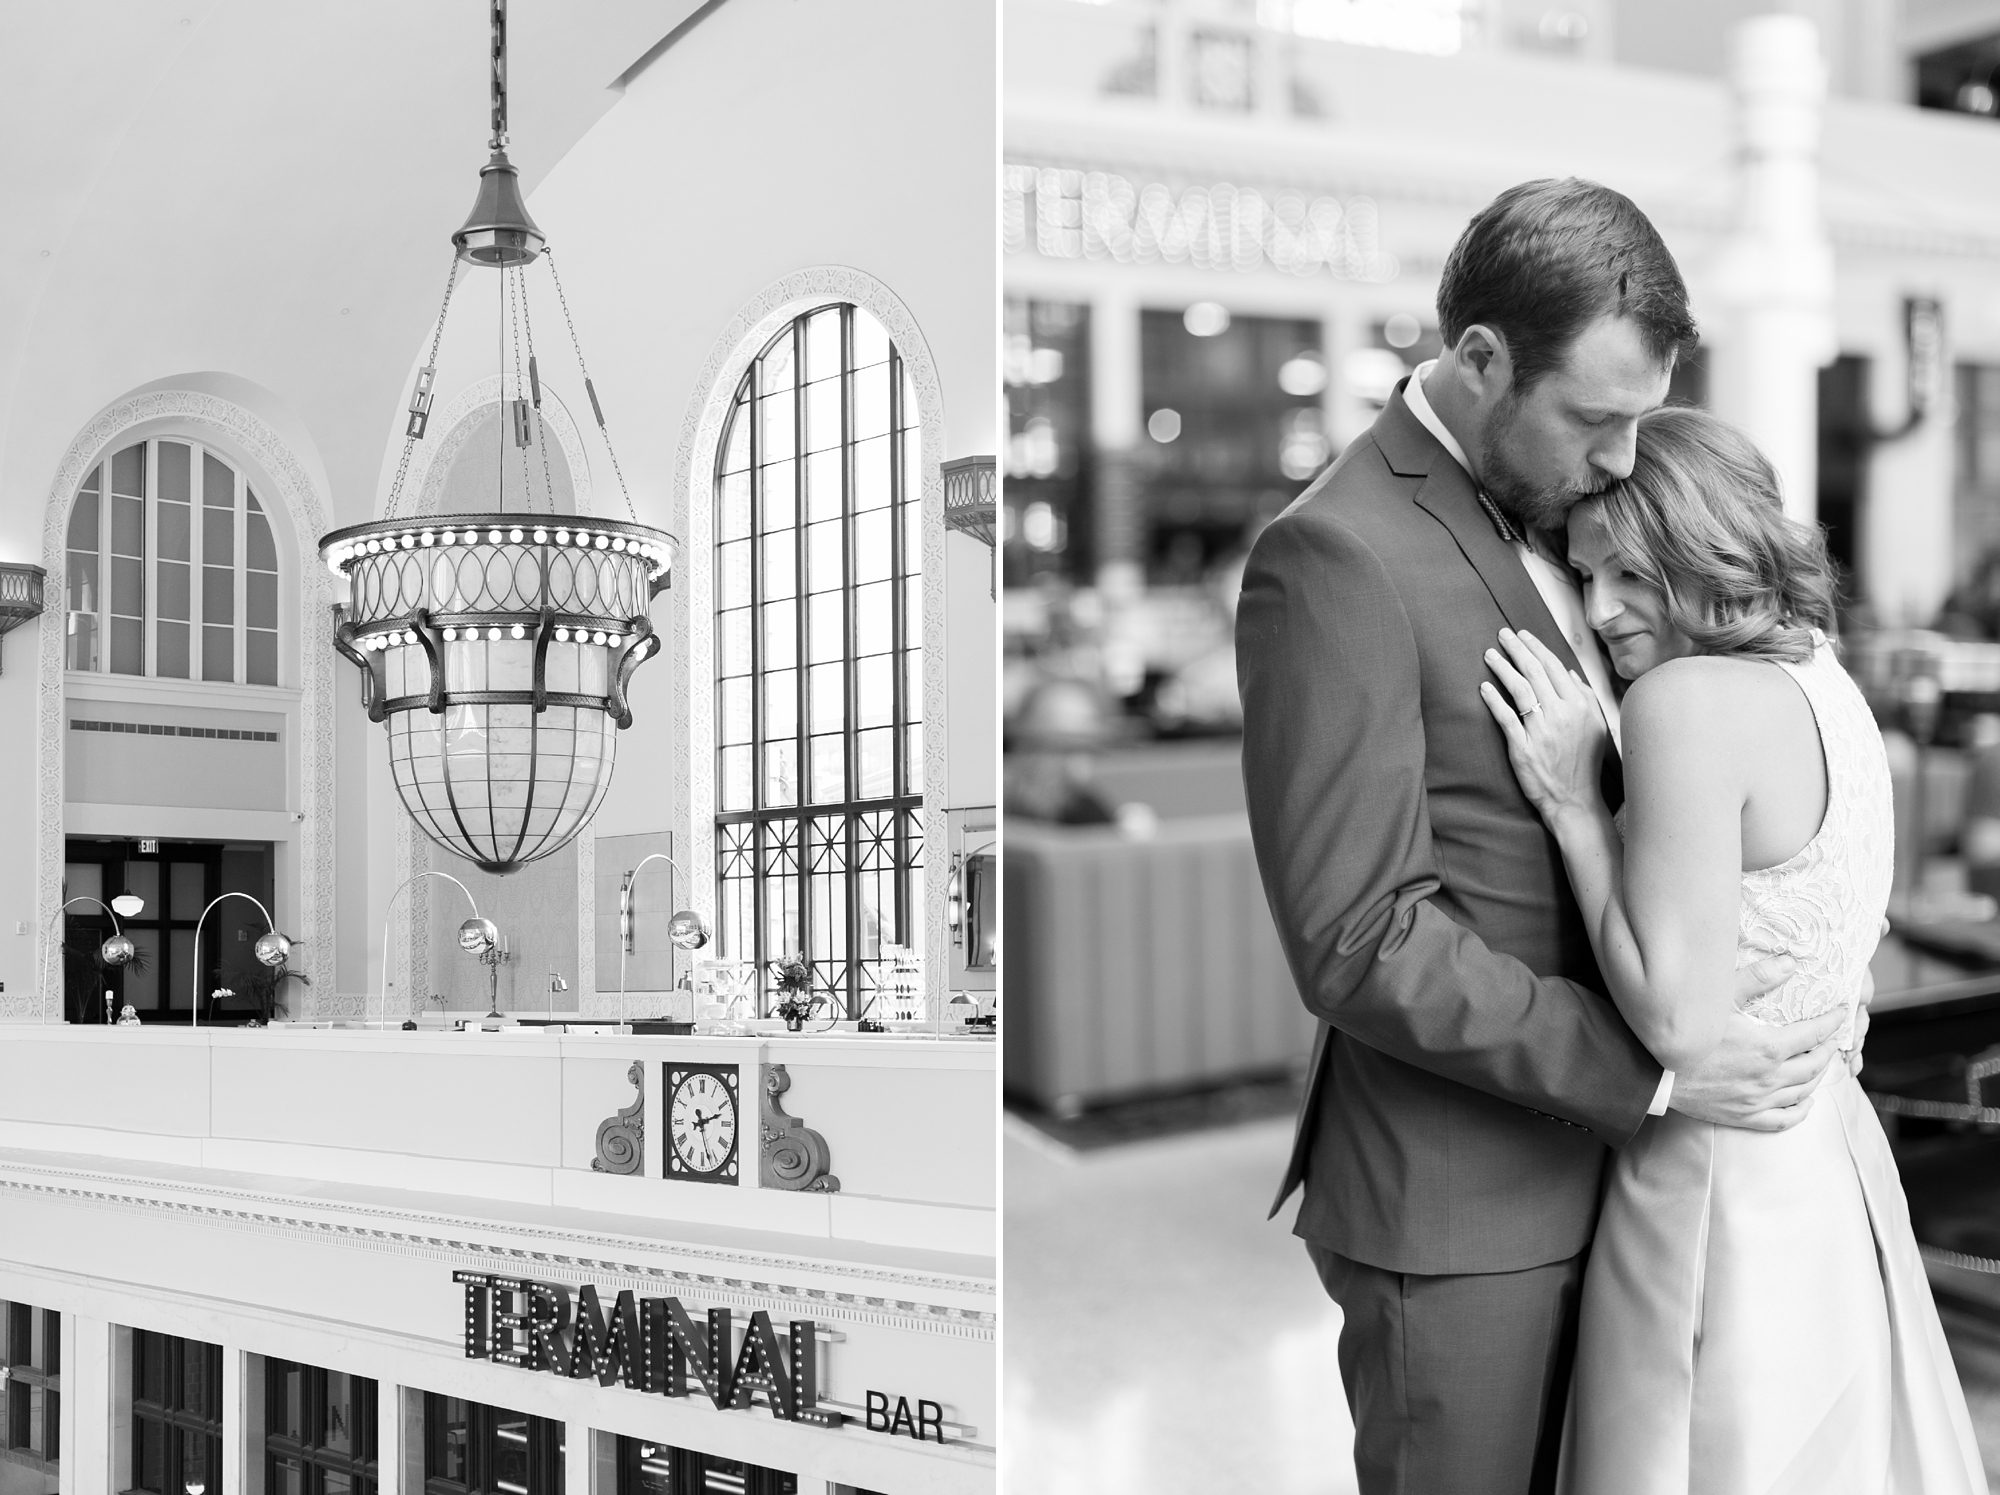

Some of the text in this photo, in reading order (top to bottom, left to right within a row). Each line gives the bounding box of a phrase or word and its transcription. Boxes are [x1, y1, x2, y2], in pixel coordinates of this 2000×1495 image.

[141, 839, 156, 853] EXIT
[453, 1270, 944, 1445] TERMINAL BAR
